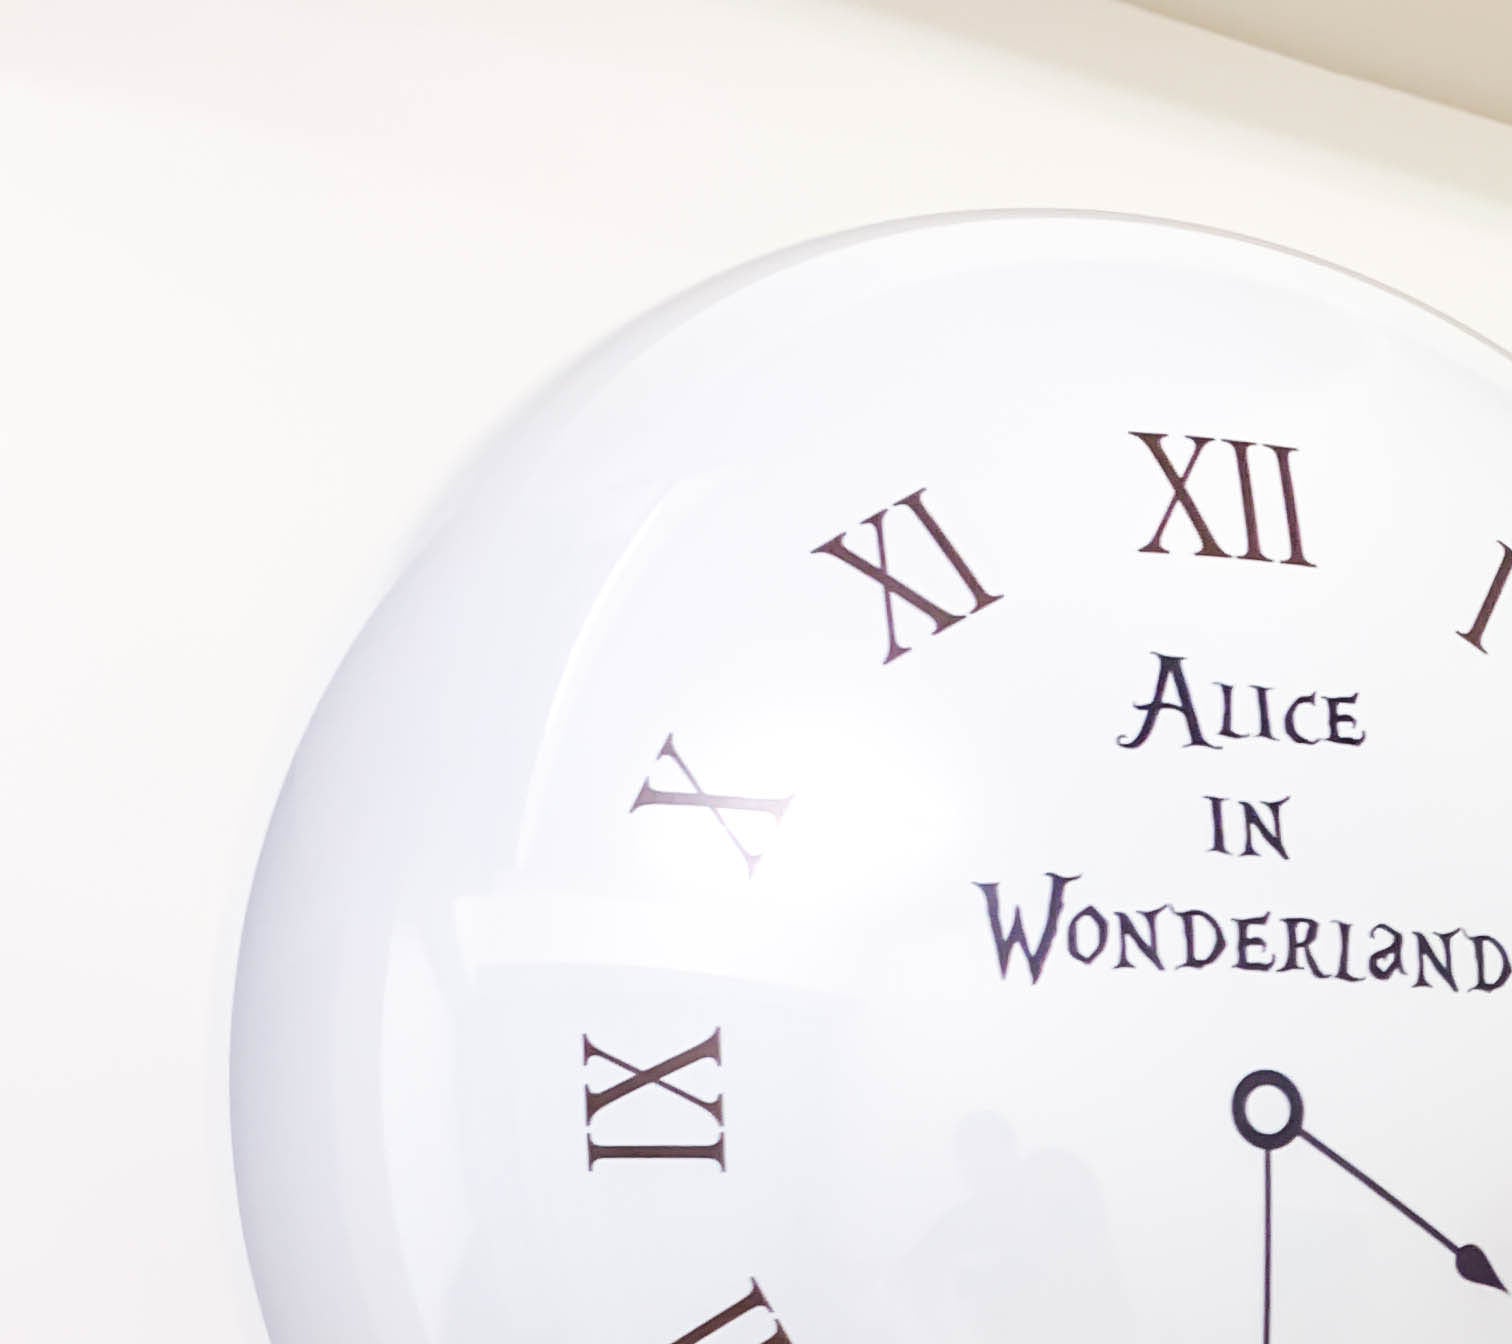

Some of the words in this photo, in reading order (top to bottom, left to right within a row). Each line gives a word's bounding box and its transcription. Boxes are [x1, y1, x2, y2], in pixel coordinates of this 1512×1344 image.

[1127, 430, 1318, 569] XII
[809, 487, 1005, 666] XI
[628, 731, 794, 878] X
[581, 1026, 727, 1173] IX
